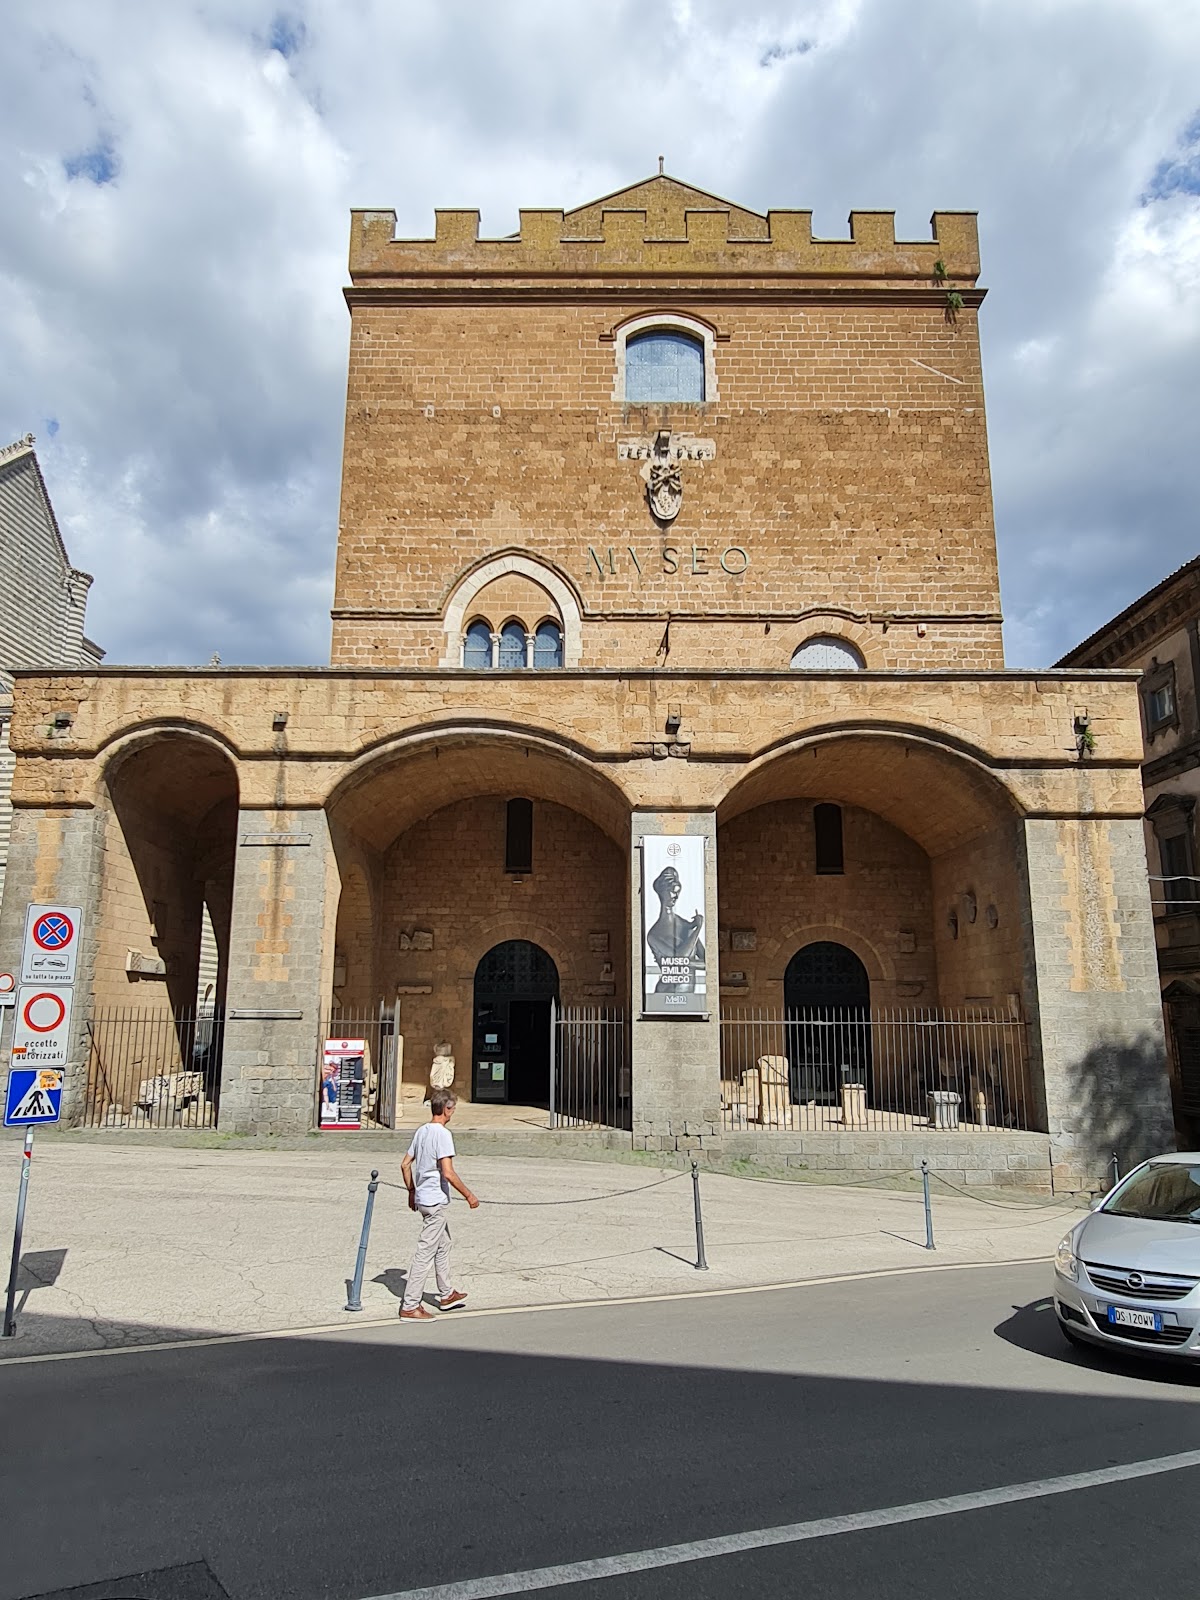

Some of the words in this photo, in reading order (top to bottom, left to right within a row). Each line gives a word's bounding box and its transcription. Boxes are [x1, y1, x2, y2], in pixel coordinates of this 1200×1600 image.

[661, 957, 690, 966] MUSEO
[661, 966, 690, 975] EMILIO
[661, 975, 690, 984] GRECO
[24, 1039, 58, 1048] eccetto
[16, 1050, 64, 1060] autorizzati
